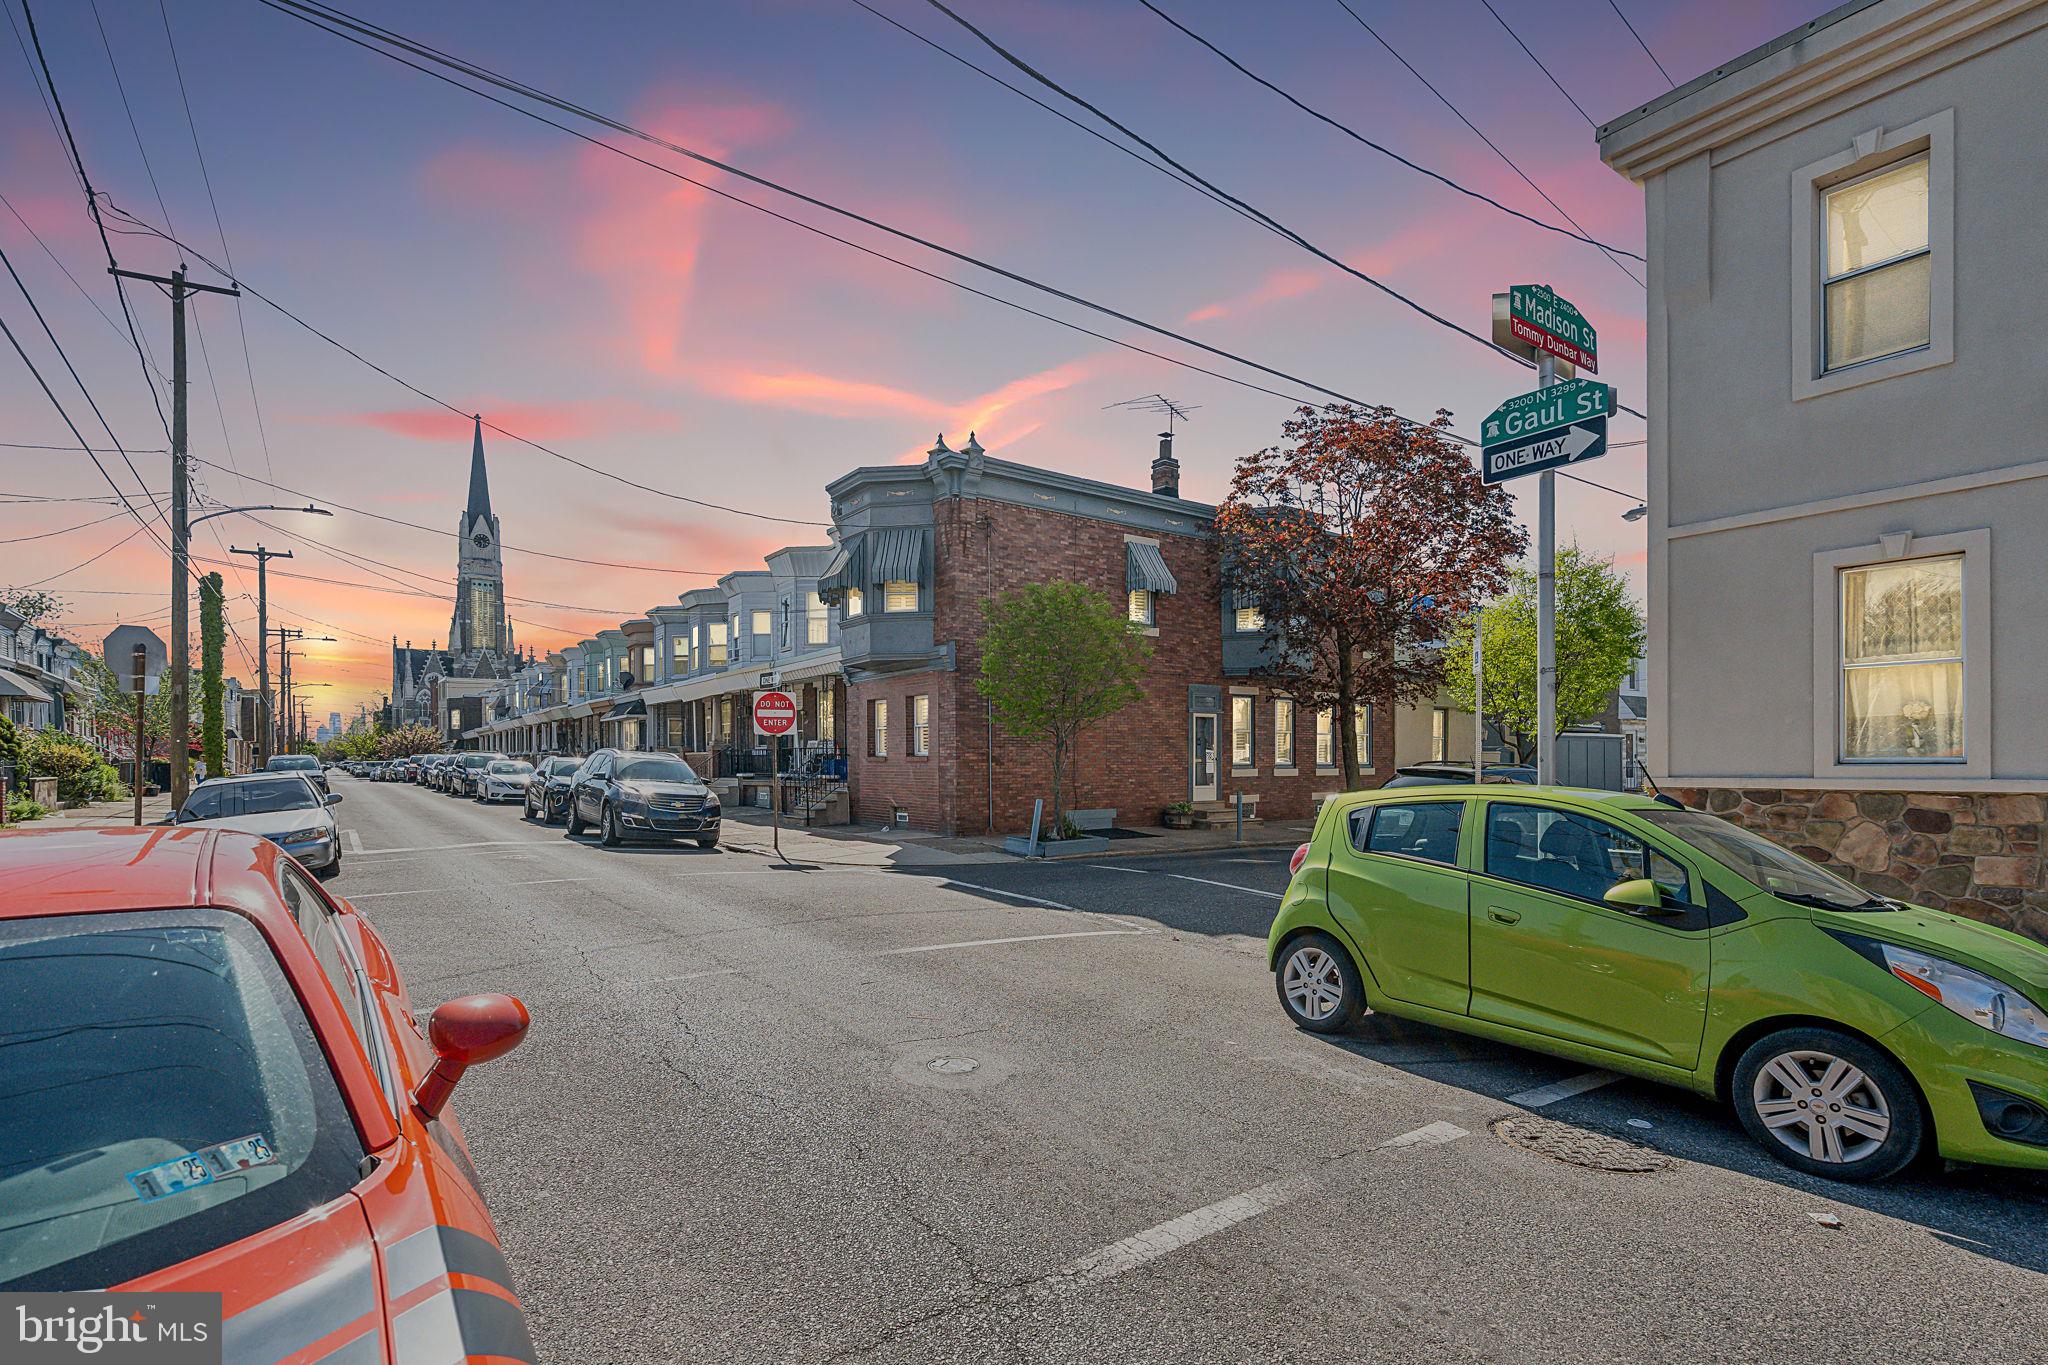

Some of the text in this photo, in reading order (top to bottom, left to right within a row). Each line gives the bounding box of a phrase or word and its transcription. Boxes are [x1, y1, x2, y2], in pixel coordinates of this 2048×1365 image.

[1553, 296, 1558, 308] E
[1525, 294, 1595, 351] Madison St
[1513, 318, 1596, 372] Tommy Dunbar Way
[1508, 382, 1576, 410] 3200 N 3299
[1505, 390, 1603, 435] Gaul St
[1495, 438, 1567, 470] ONE WAY
[761, 700, 790, 708] DO NOT
[248, 1138, 271, 1160] 25
[182, 1157, 207, 1180] 25
